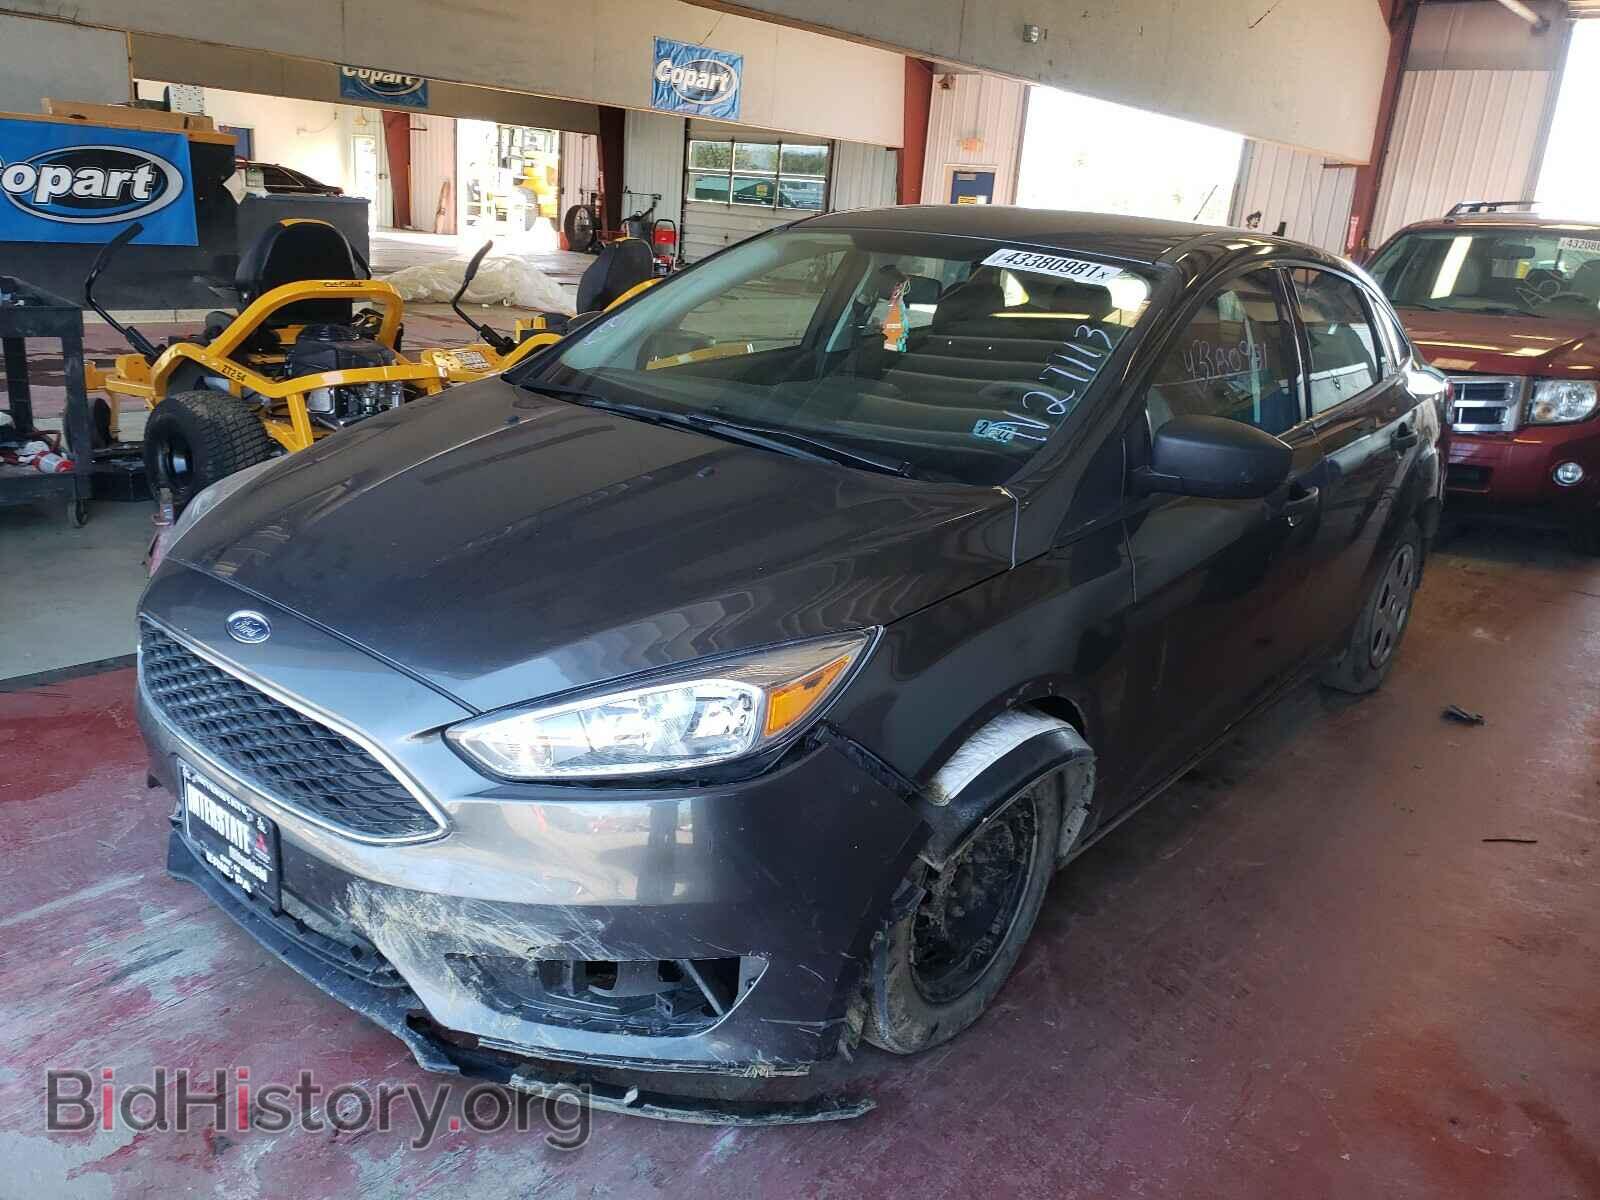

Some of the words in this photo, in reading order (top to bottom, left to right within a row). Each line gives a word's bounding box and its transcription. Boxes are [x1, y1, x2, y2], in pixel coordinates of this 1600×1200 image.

[655, 58, 731, 93] Copart
[0, 161, 155, 205] opart
[1003, 251, 1100, 278] 43380981
[186, 783, 252, 855] INTERSTATE
